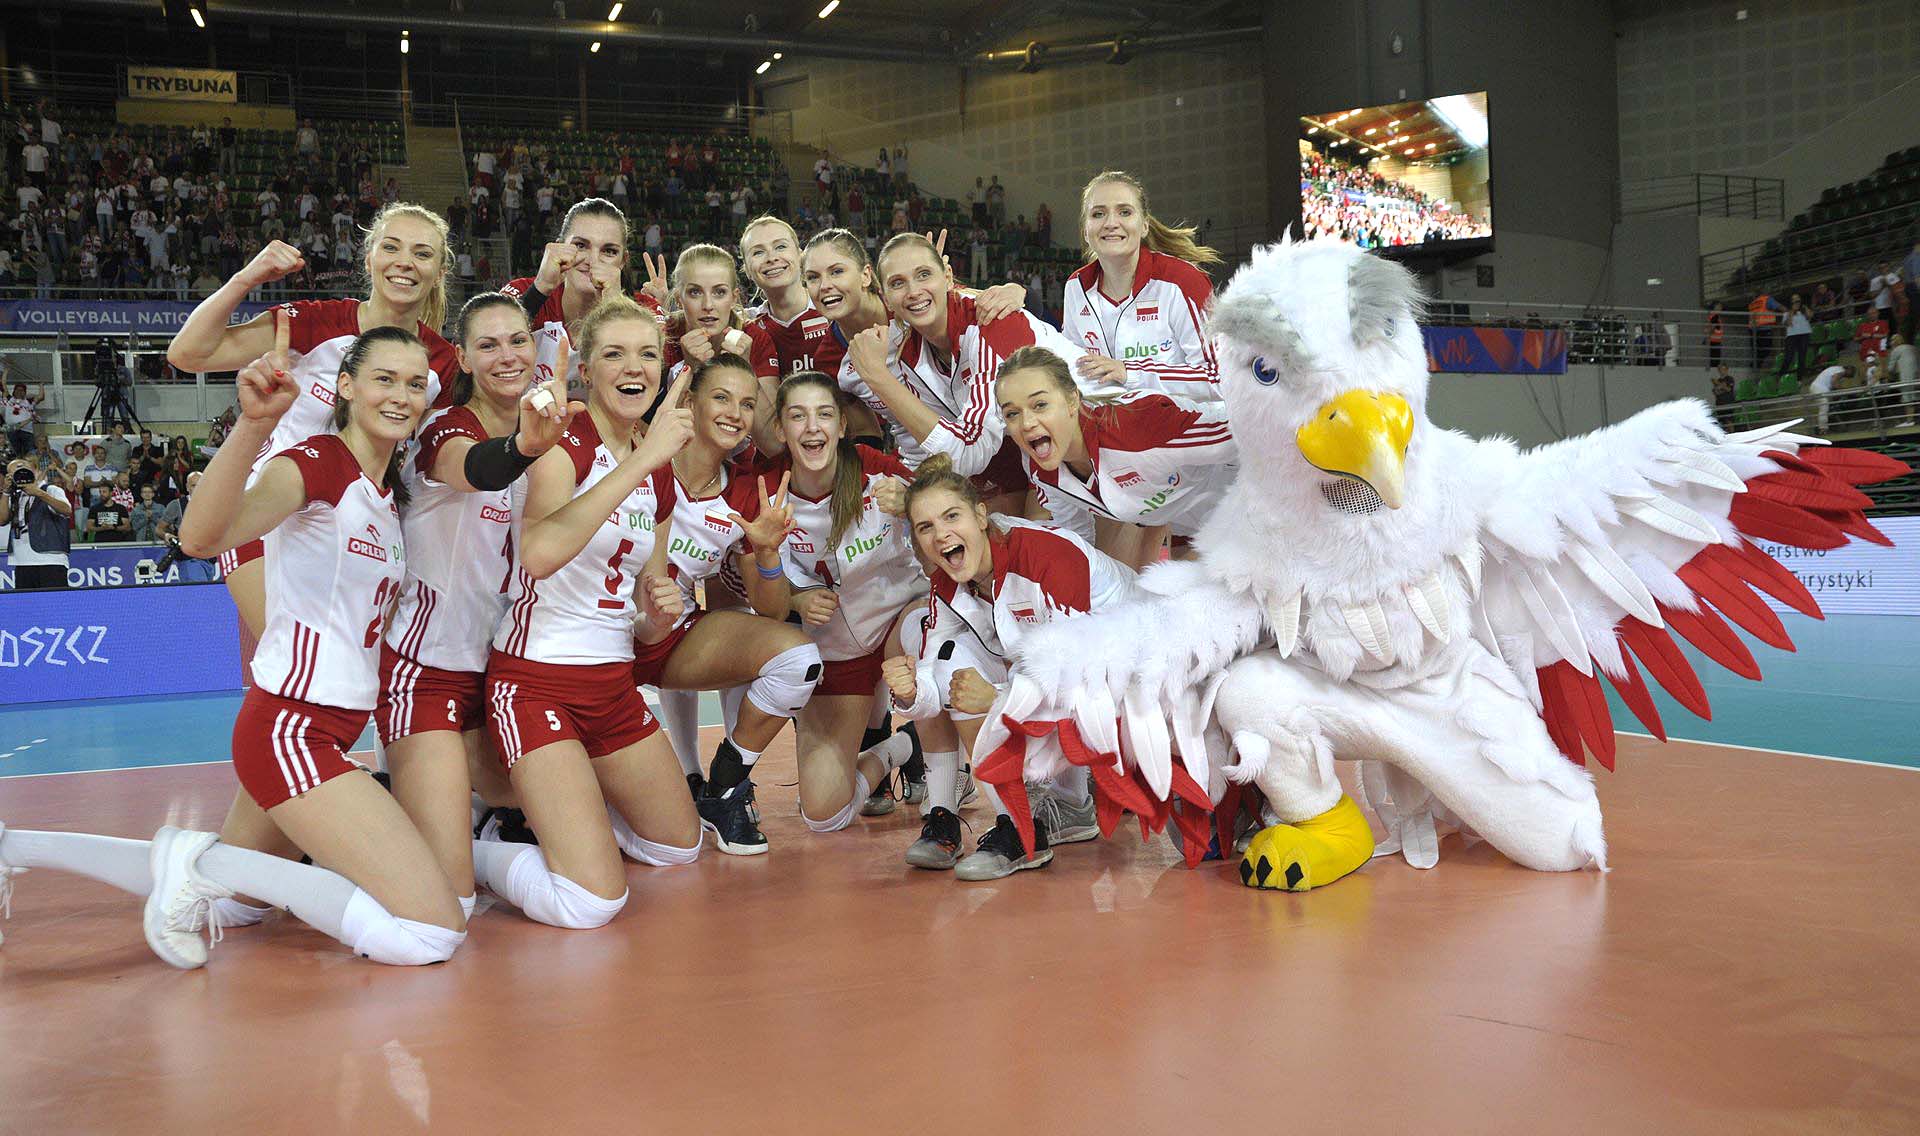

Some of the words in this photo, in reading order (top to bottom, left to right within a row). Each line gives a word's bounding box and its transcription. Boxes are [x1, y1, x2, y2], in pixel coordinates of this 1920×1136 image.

[131, 75, 234, 94] TRYBUNA
[18, 310, 131, 325] VOLLEYBALL
[804, 330, 827, 340] POLSK
[1124, 341, 1159, 359] plus
[704, 520, 731, 535] POLSKA
[350, 541, 386, 562] ORLEN
[669, 538, 709, 562] plus
[844, 534, 883, 562] plus
[604, 538, 635, 596] 5
[447, 699, 457, 723] 2
[544, 710, 561, 731] 5
